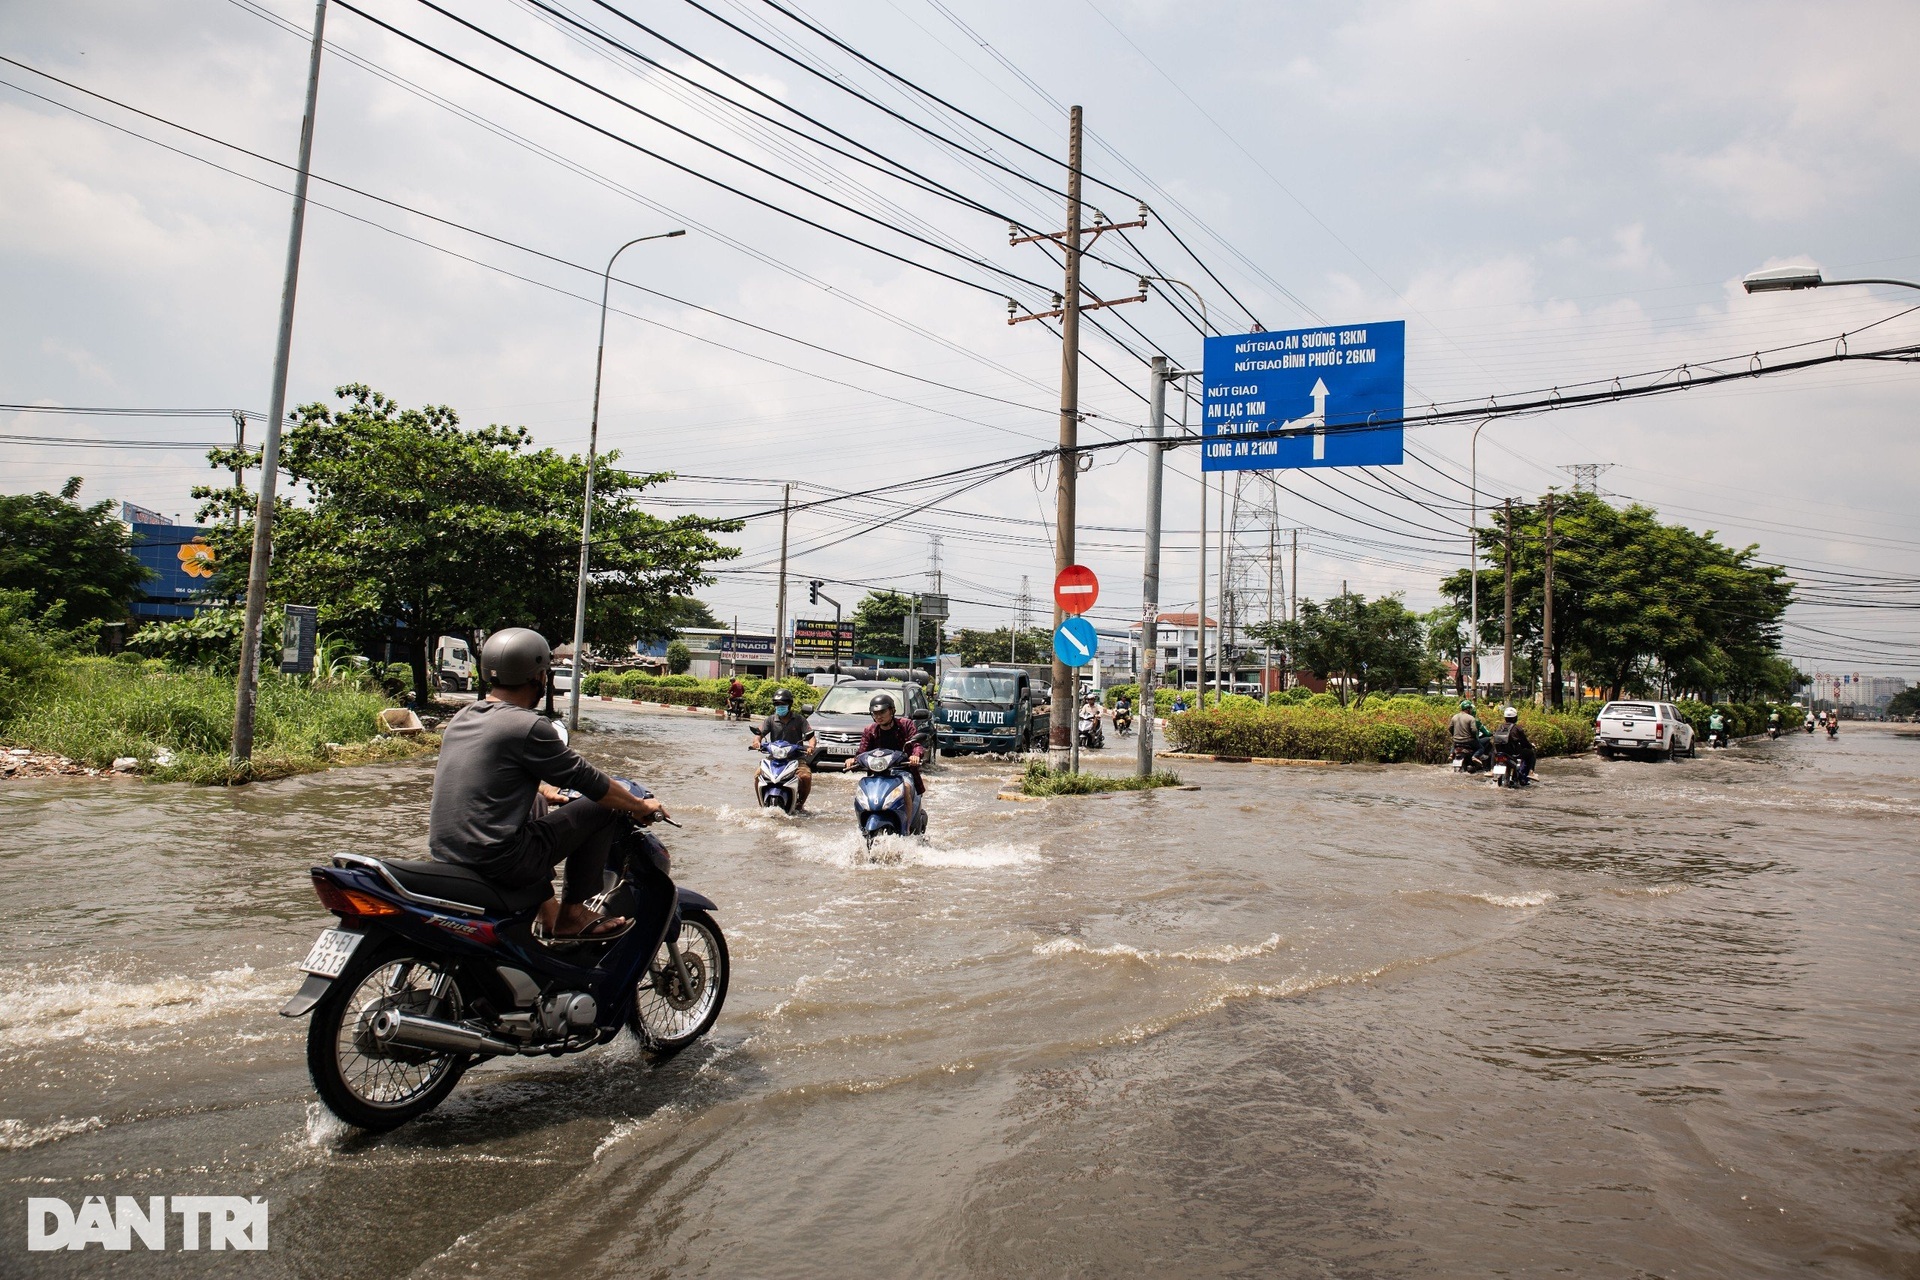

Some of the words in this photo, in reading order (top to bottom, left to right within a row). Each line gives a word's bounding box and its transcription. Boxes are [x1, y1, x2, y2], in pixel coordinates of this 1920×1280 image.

[1284, 335, 1299, 350] AN
[1301, 331, 1336, 348] SƯƠNG
[1339, 329, 1367, 345] 13KM
[1282, 351, 1306, 368] BÌNH
[1308, 347, 1343, 367] PHƯỚC
[1345, 348, 1376, 364] 26KM
[1208, 383, 1230, 397] NÚT
[1231, 385, 1258, 395] GIAO
[1207, 404, 1221, 418] AN
[1224, 402, 1243, 419] LẠC
[1245, 401, 1266, 415] 1KM
[1207, 443, 1232, 458] LONG
[1234, 442, 1248, 456] AN
[1251, 441, 1278, 455] 21KM
[731, 642, 768, 650] PINACO
[946, 709, 972, 724] PHUC
[977, 711, 1005, 724] MINH
[319, 932, 354, 953] 59-E1
[304, 951, 346, 975] 425.13
